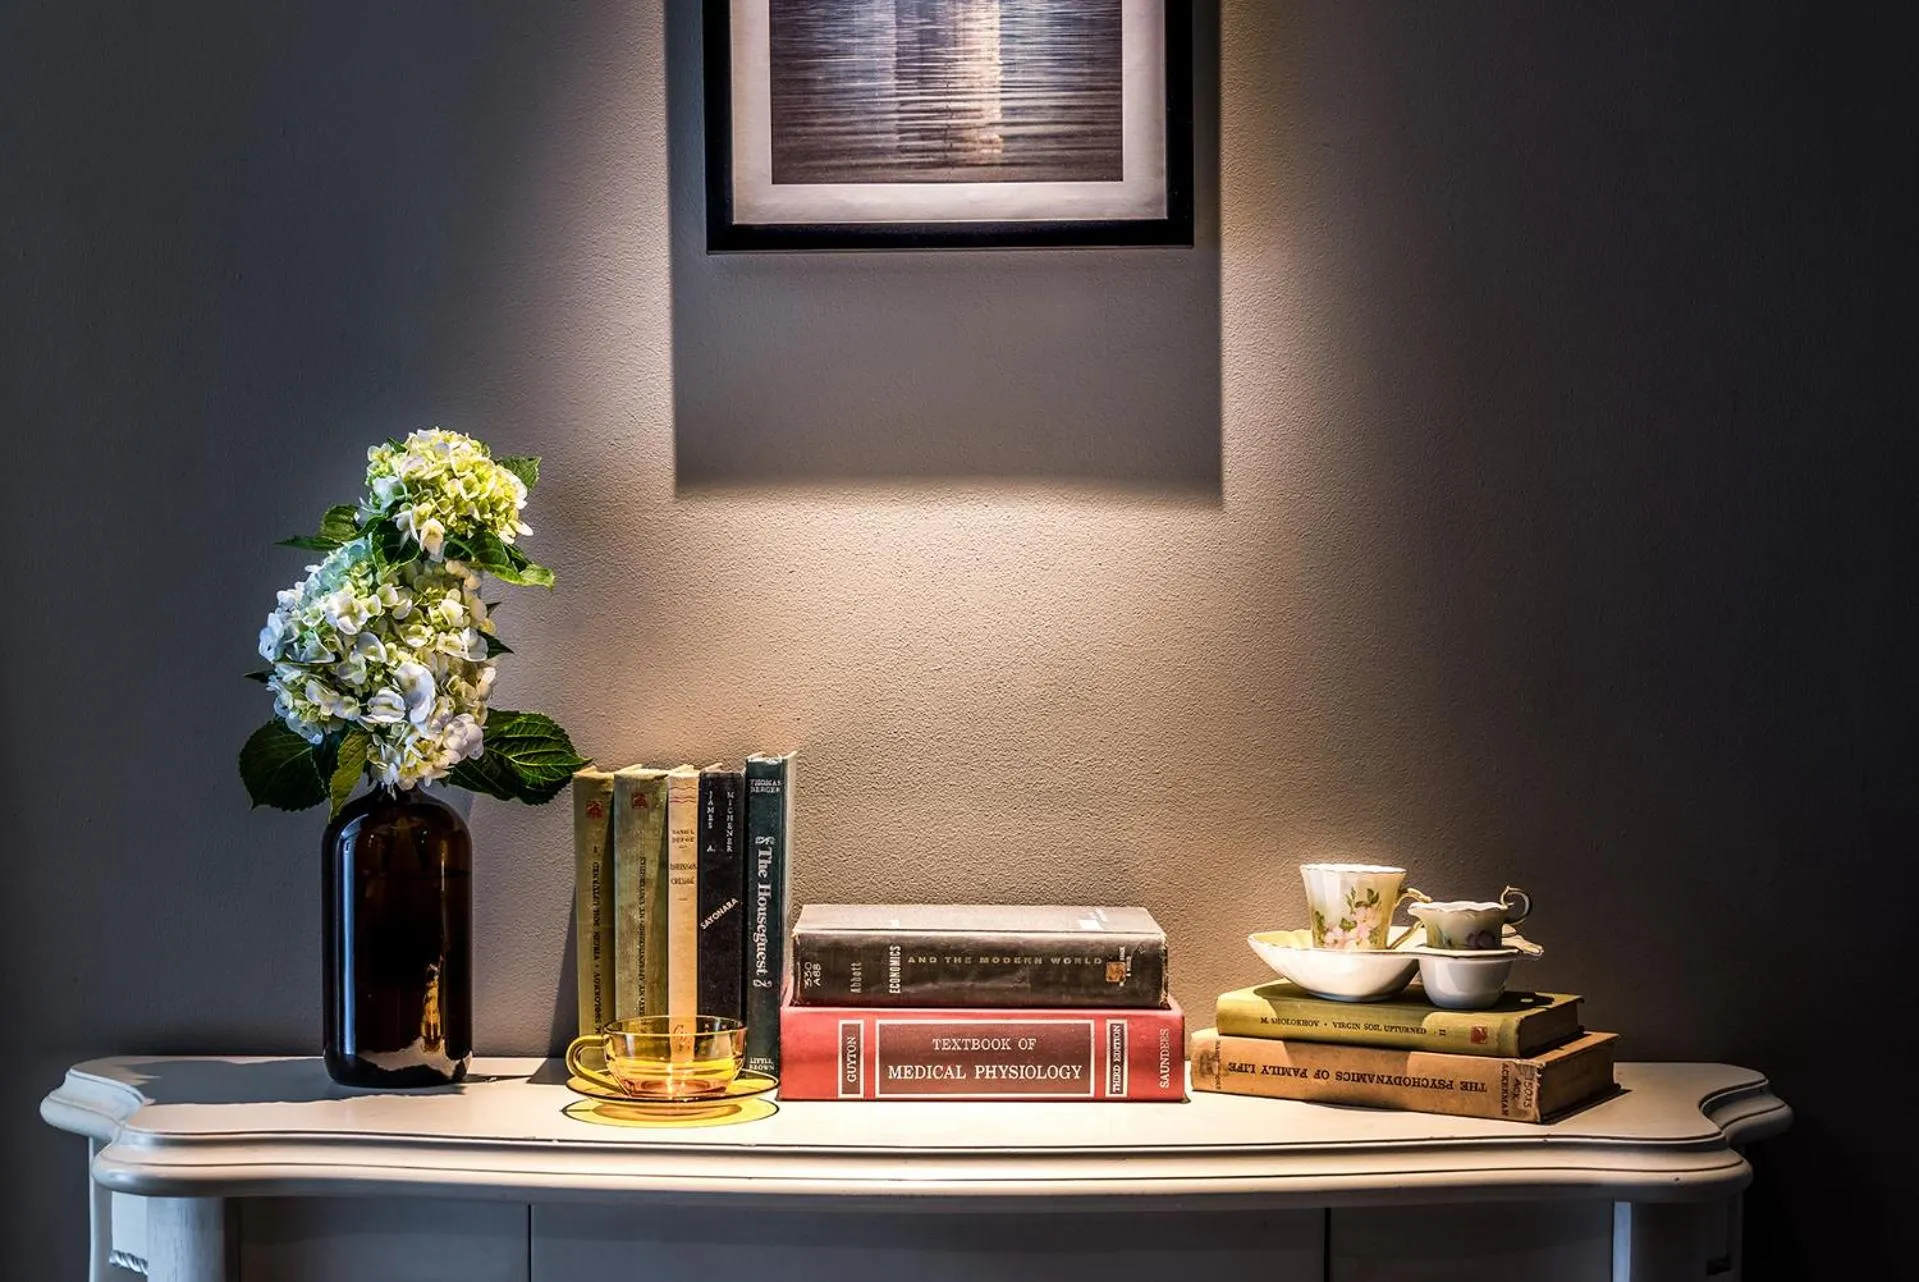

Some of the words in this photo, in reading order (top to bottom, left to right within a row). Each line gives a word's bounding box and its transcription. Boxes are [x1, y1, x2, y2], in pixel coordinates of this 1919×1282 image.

[706, 791, 715, 829] JAMES
[725, 791, 735, 853] MICHENER
[757, 848, 773, 878] The
[700, 898, 739, 931] SAYONARA
[752, 882, 773, 975] Houseguest
[804, 961, 813, 988] 330
[889, 945, 901, 994] ECONOMICS
[908, 956, 937, 964] AND
[945, 956, 972, 965] THE
[979, 956, 1042, 965] MODERN
[1051, 956, 1103, 965] WORLD
[850, 962, 862, 994] Abbott
[1332, 1021, 1361, 1030] VIRGIN
[1363, 1022, 1383, 1032] SOIL
[1383, 1025, 1428, 1035] UPTURNED
[932, 1038, 1012, 1051] TEXTBOOK
[1018, 1038, 1037, 1051] OF
[1112, 1024, 1122, 1063] EDITION
[846, 1036, 857, 1083] GUYTON
[888, 1065, 967, 1080] MEDICAL
[974, 1065, 1083, 1080] PHYSIOLOGY
[1159, 1028, 1170, 1089] SAUNDERS
[1228, 1061, 1256, 1074] LIFE
[1261, 1064, 1308, 1079] FAMILY
[1112, 1064, 1122, 1093] THIRD
[1314, 1070, 1330, 1081] OF
[1335, 1070, 1454, 1091] PSYCHODYNAMICS
[1460, 1080, 1488, 1093] THE
[1501, 1063, 1509, 1116] ACKERMAN
